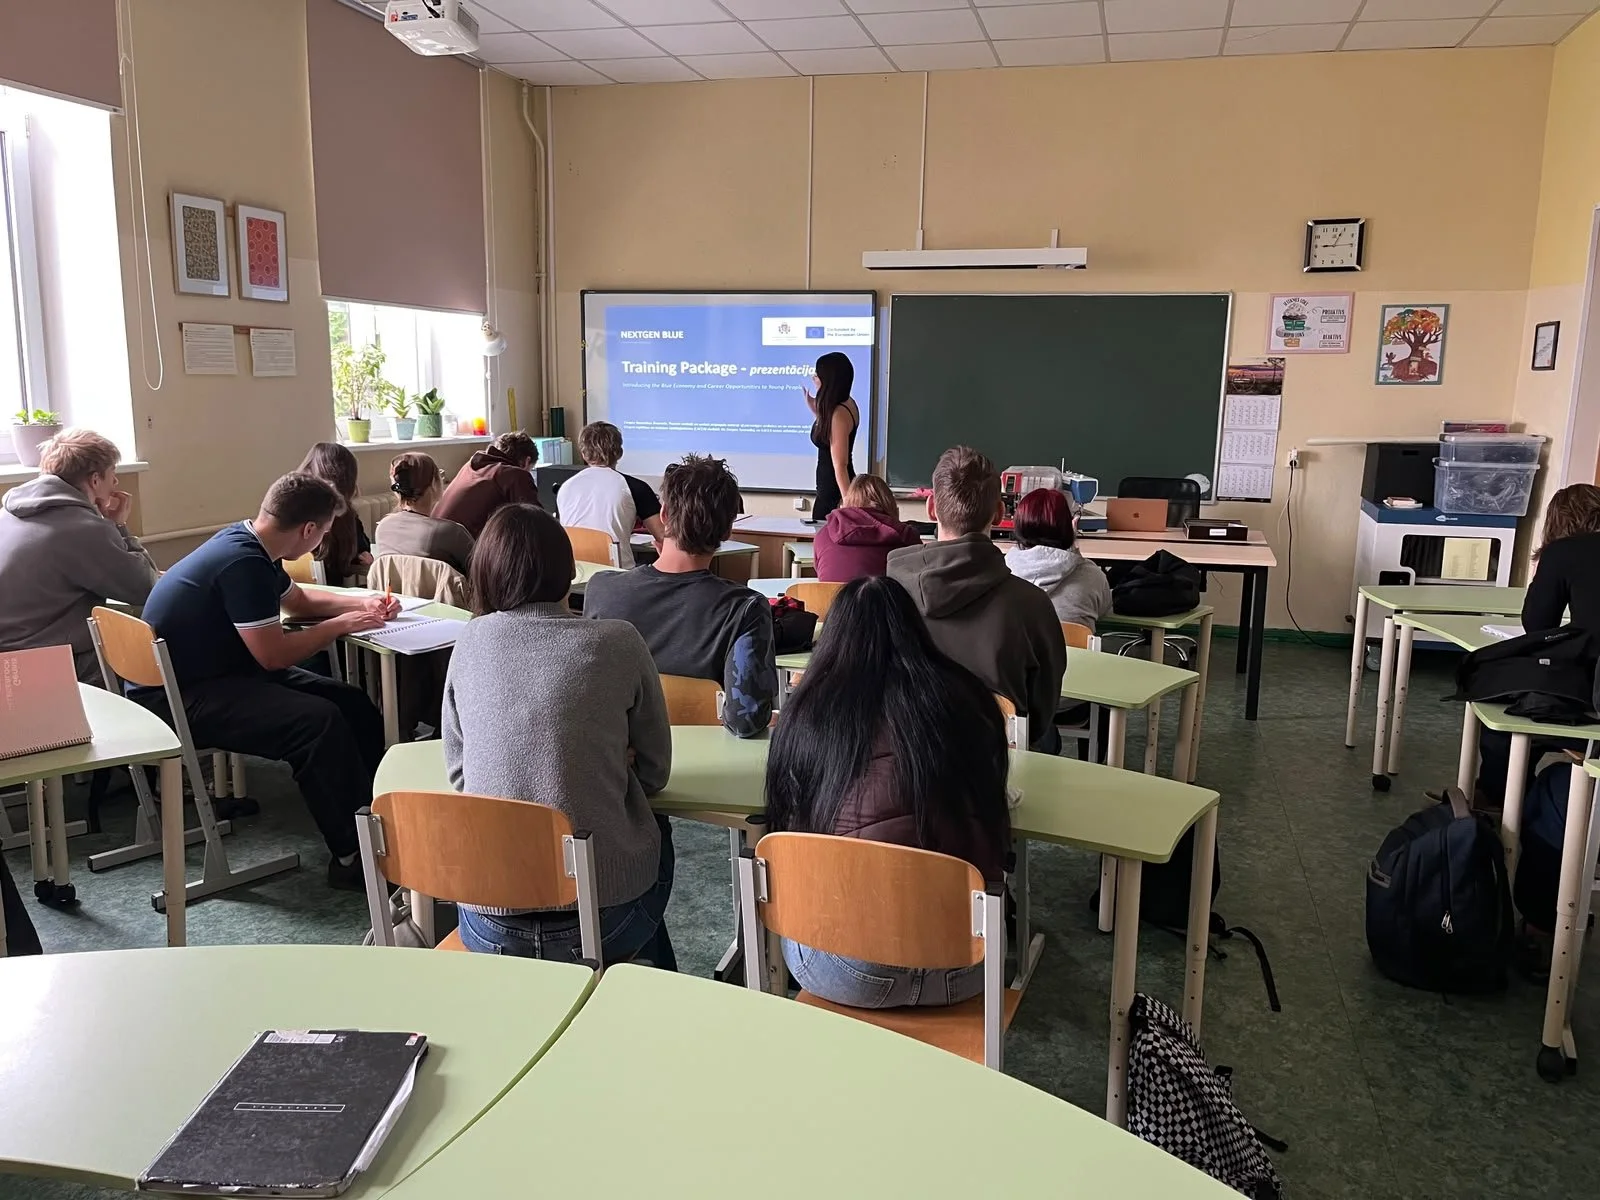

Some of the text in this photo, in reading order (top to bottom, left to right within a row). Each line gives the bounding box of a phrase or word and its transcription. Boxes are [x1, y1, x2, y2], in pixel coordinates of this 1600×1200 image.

[620, 330, 684, 339] NEXTGEN BLUE
[622, 361, 677, 376] Training
[680, 361, 737, 377] Package
[750, 365, 816, 376] prezentācija
